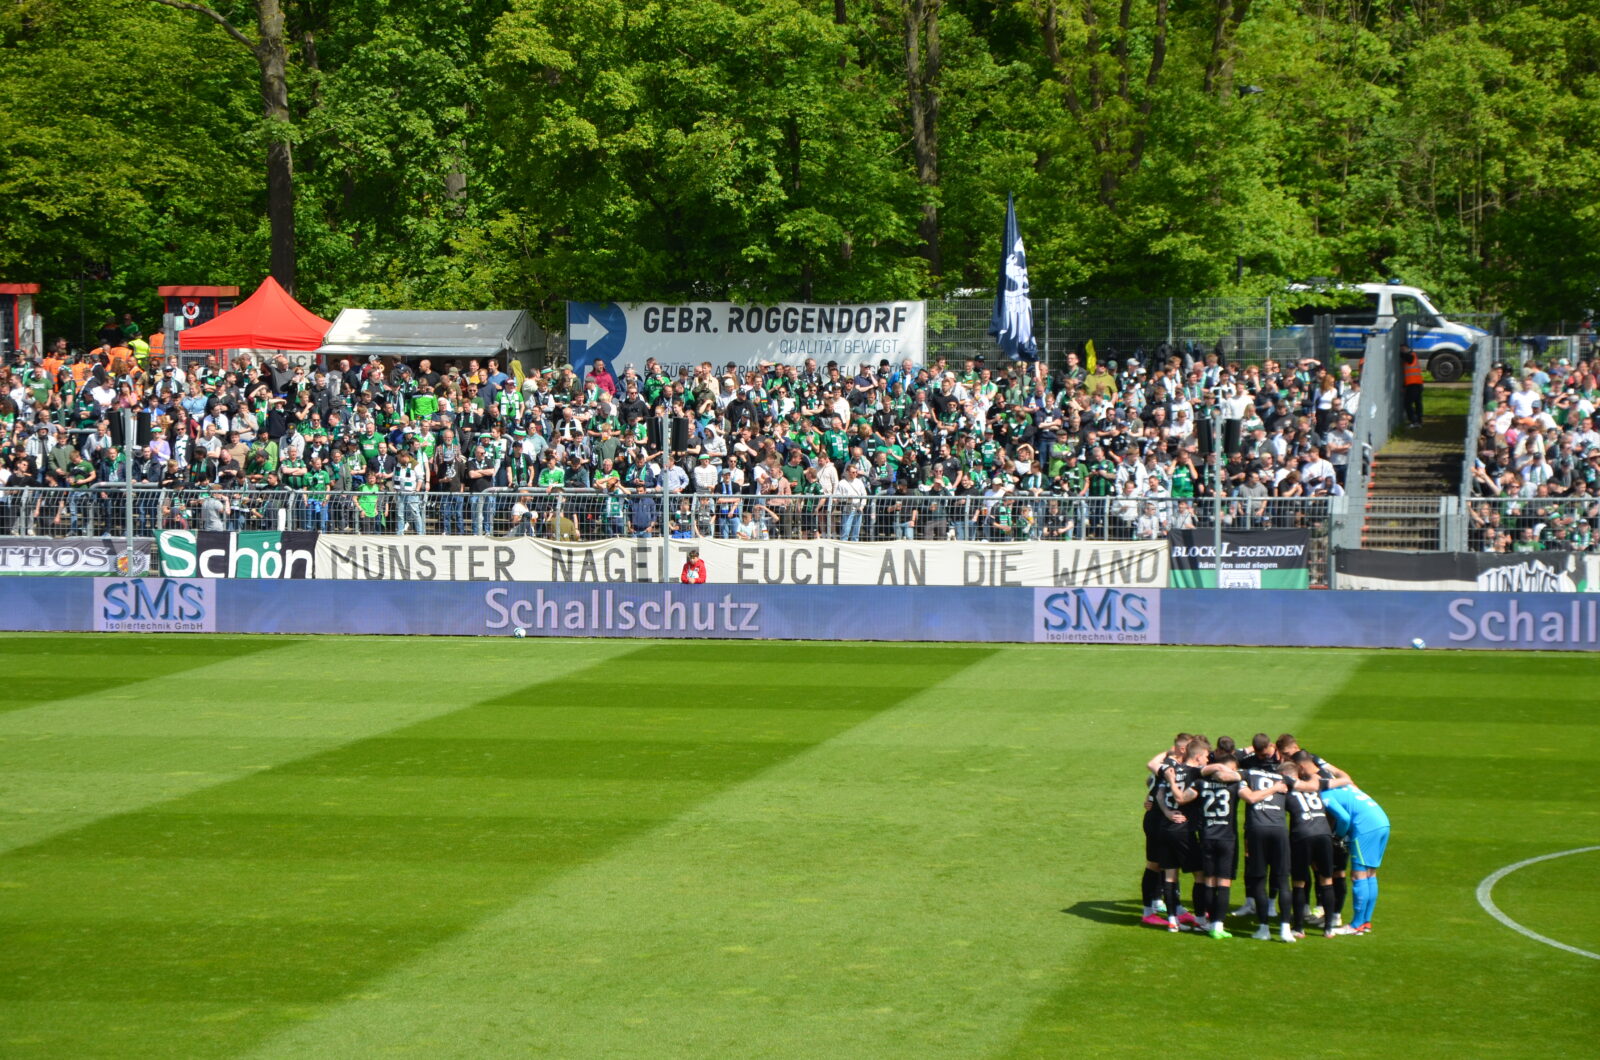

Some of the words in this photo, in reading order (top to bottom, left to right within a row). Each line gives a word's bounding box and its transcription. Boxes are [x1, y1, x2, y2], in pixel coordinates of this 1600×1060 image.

[643, 307, 718, 333] GEBR.
[728, 307, 907, 333] ROGGENDORF
[780, 337, 839, 354] QUALITÄT
[844, 339, 901, 354] BEWEGT.
[159, 530, 314, 578] Schön
[1172, 545, 1217, 557] BLOCK
[329, 544, 516, 581] MÜNSTER
[551, 547, 700, 583] NAGELT
[737, 547, 840, 584] EUCH
[877, 548, 926, 585] AN
[963, 550, 1023, 586] DIE
[1053, 549, 1160, 587] WAND
[1198, 562, 1233, 570] kämfen
[103, 578, 206, 621] SMS
[484, 588, 760, 631] Schallschutz
[1044, 588, 1150, 632] SMS
[106, 622, 172, 630] Isoliertechnik
[174, 622, 203, 630] GmbH
[1448, 598, 1597, 642] Schall
[1046, 632, 1113, 641] Isoliertechnik
[1117, 632, 1147, 641] GmbH
[1202, 789, 1230, 817] 23
[1291, 791, 1323, 812] 18
